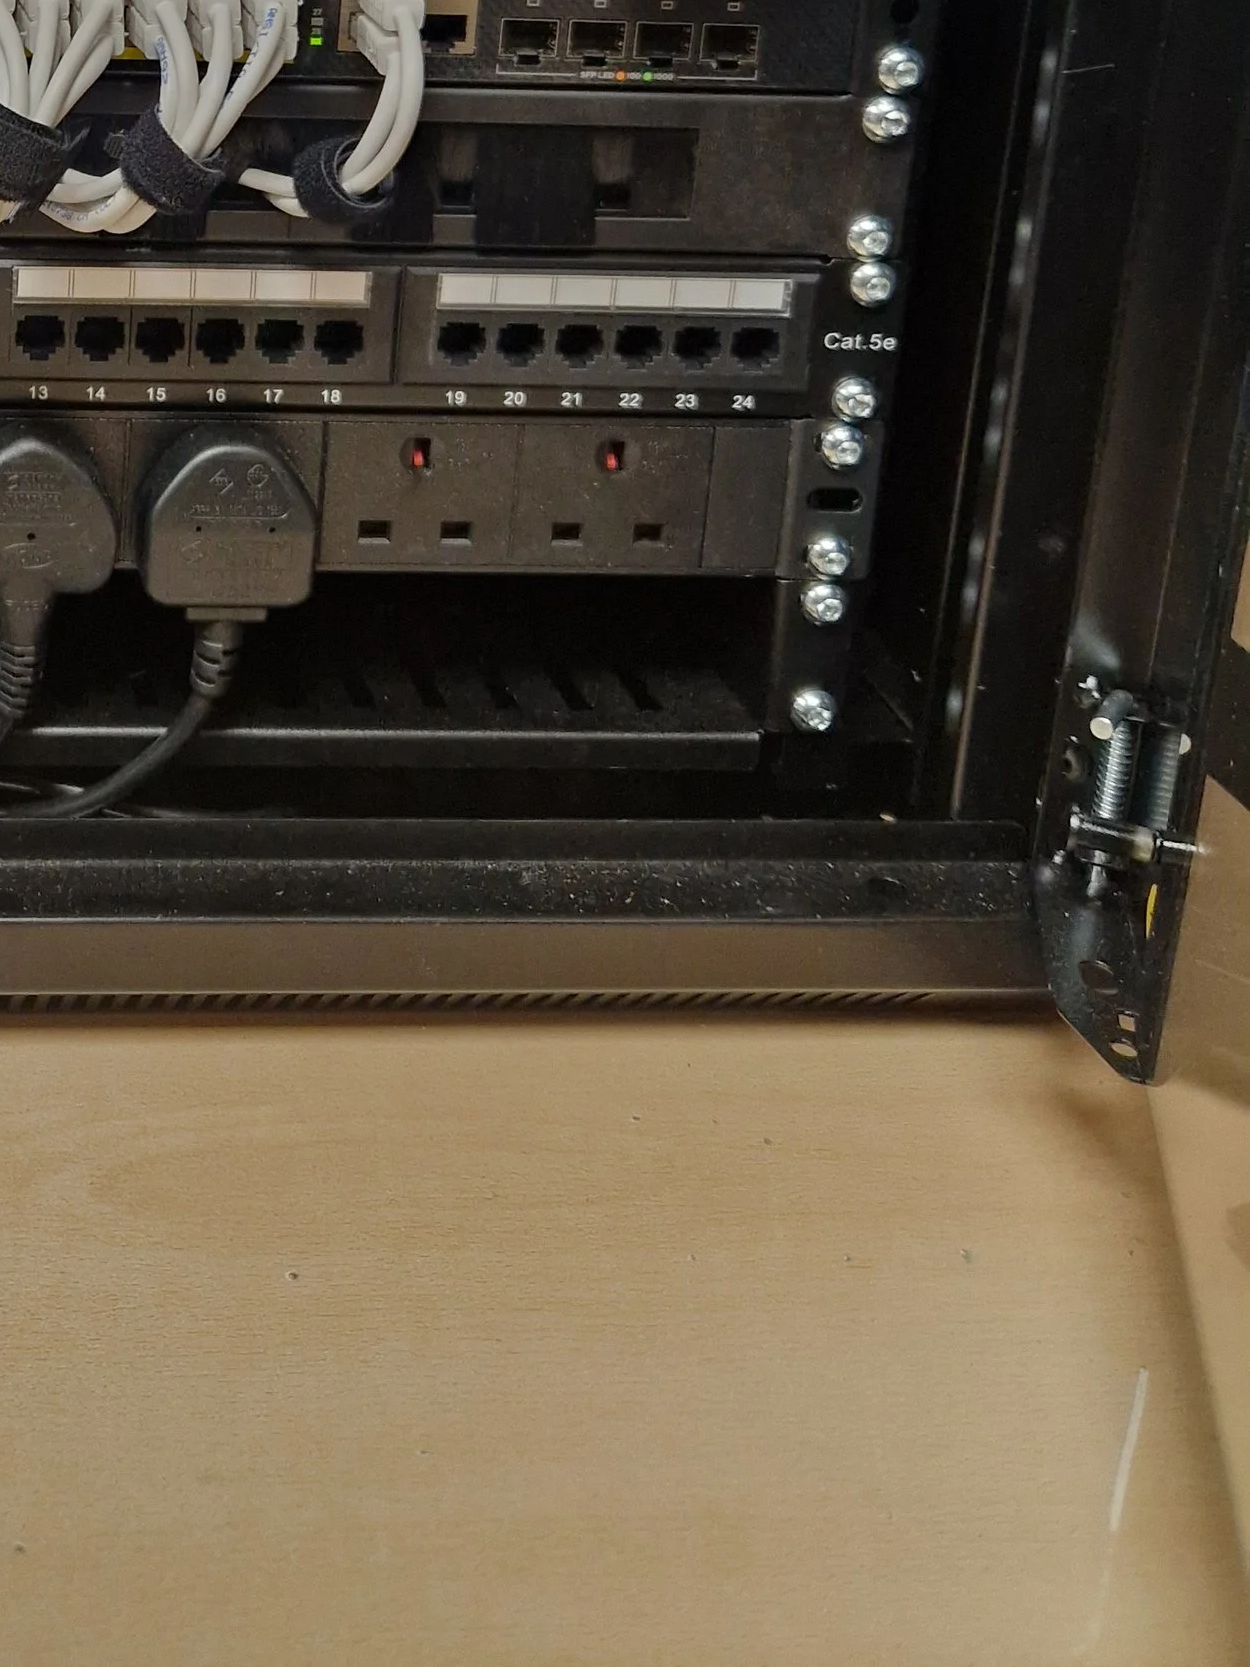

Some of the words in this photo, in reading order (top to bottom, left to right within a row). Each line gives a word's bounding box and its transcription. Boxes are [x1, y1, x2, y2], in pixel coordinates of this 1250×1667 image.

[824, 333, 896, 351] Cat.5e
[30, 386, 48, 399] 13
[87, 387, 105, 400] 14
[147, 388, 166, 401] 15
[207, 389, 225, 402] 16
[264, 389, 283, 403] 17
[322, 390, 341, 404] 18
[446, 391, 466, 405] 19
[504, 392, 526, 405] 20
[561, 392, 581, 407] 21
[619, 393, 641, 408] 22
[675, 394, 697, 408] 23
[732, 395, 754, 409] 24
